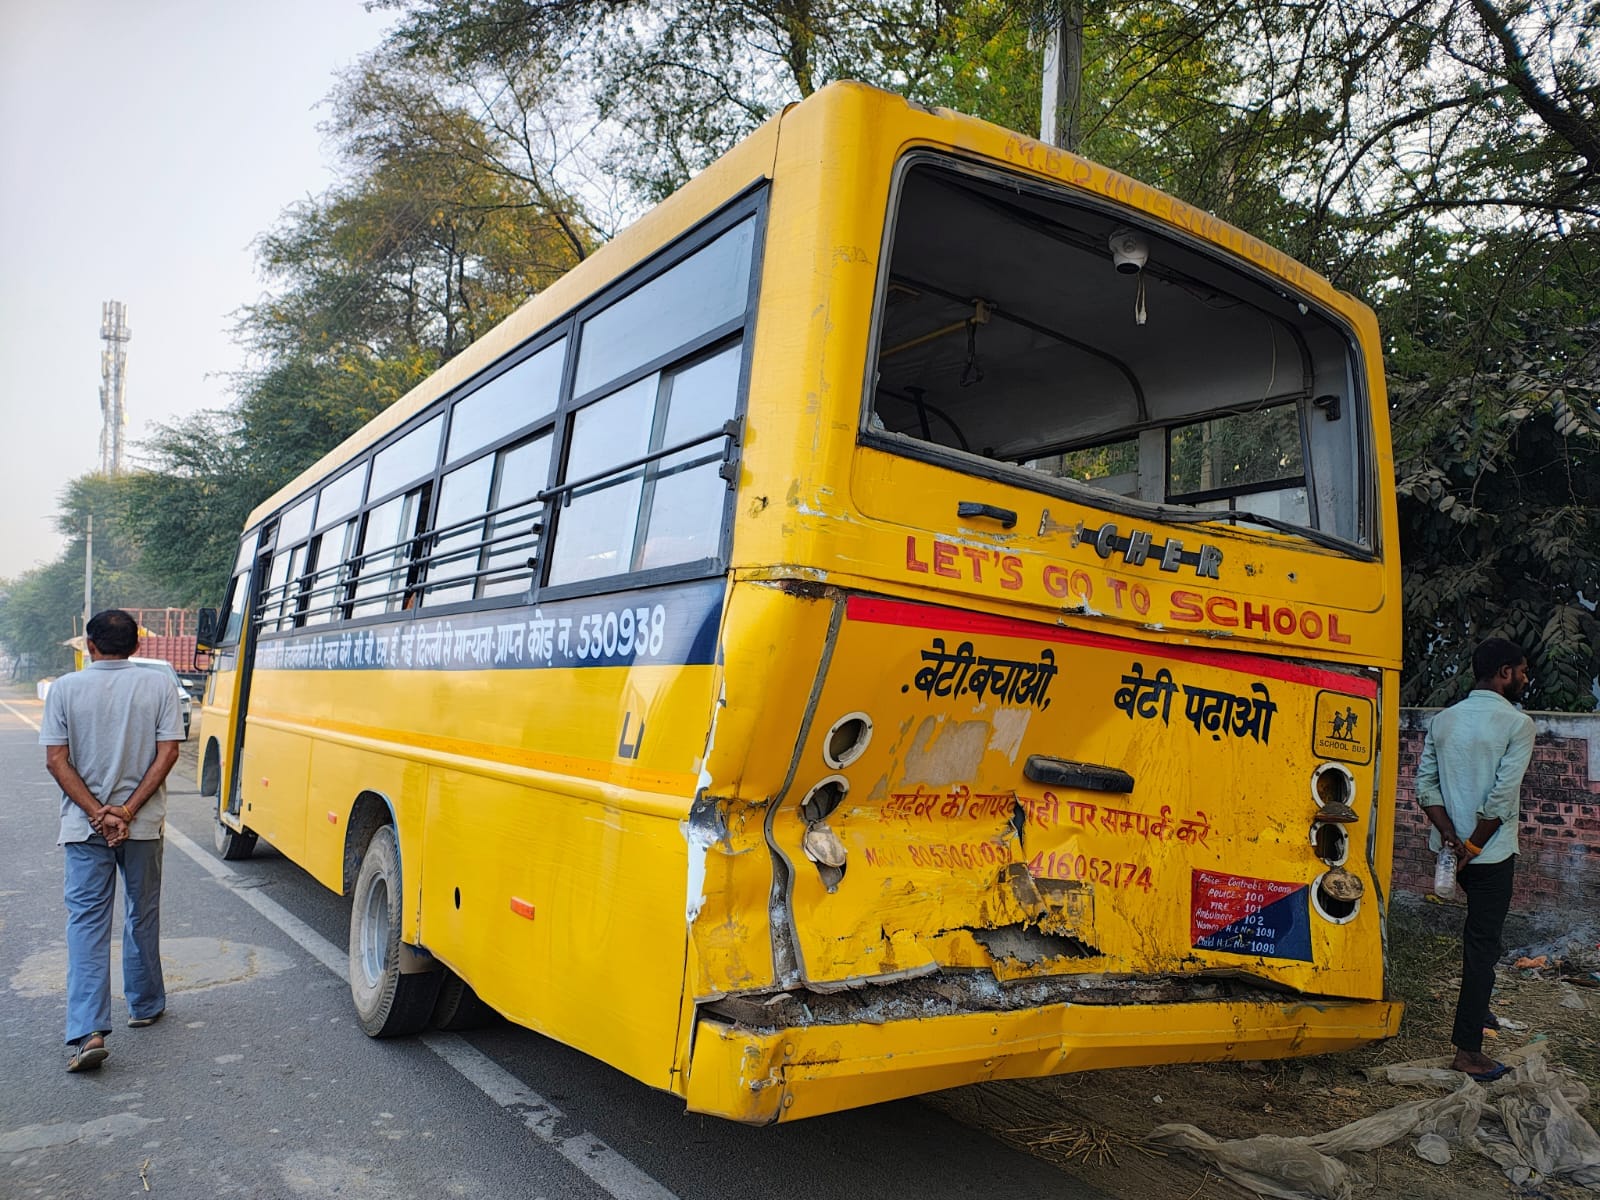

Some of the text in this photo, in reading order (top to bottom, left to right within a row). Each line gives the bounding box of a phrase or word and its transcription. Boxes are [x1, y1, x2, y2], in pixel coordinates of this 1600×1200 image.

[906, 535, 1352, 645] LET'S GO TO SCHOOL
[416, 621, 443, 666] दिल्ली
[576, 604, 666, 660] 530938
[1114, 662, 1180, 728] बेटी
[1182, 683, 1278, 747] पढ़ाओ
[1319, 739, 1366, 753] SCHOOL BUS
[1067, 800, 1100, 834] पर
[1244, 891, 1265, 903] 100
[1244, 903, 1262, 914] 101
[1244, 915, 1265, 926] 102
[1255, 926, 1276, 939] 1091
[1250, 940, 1276, 954] 1098
